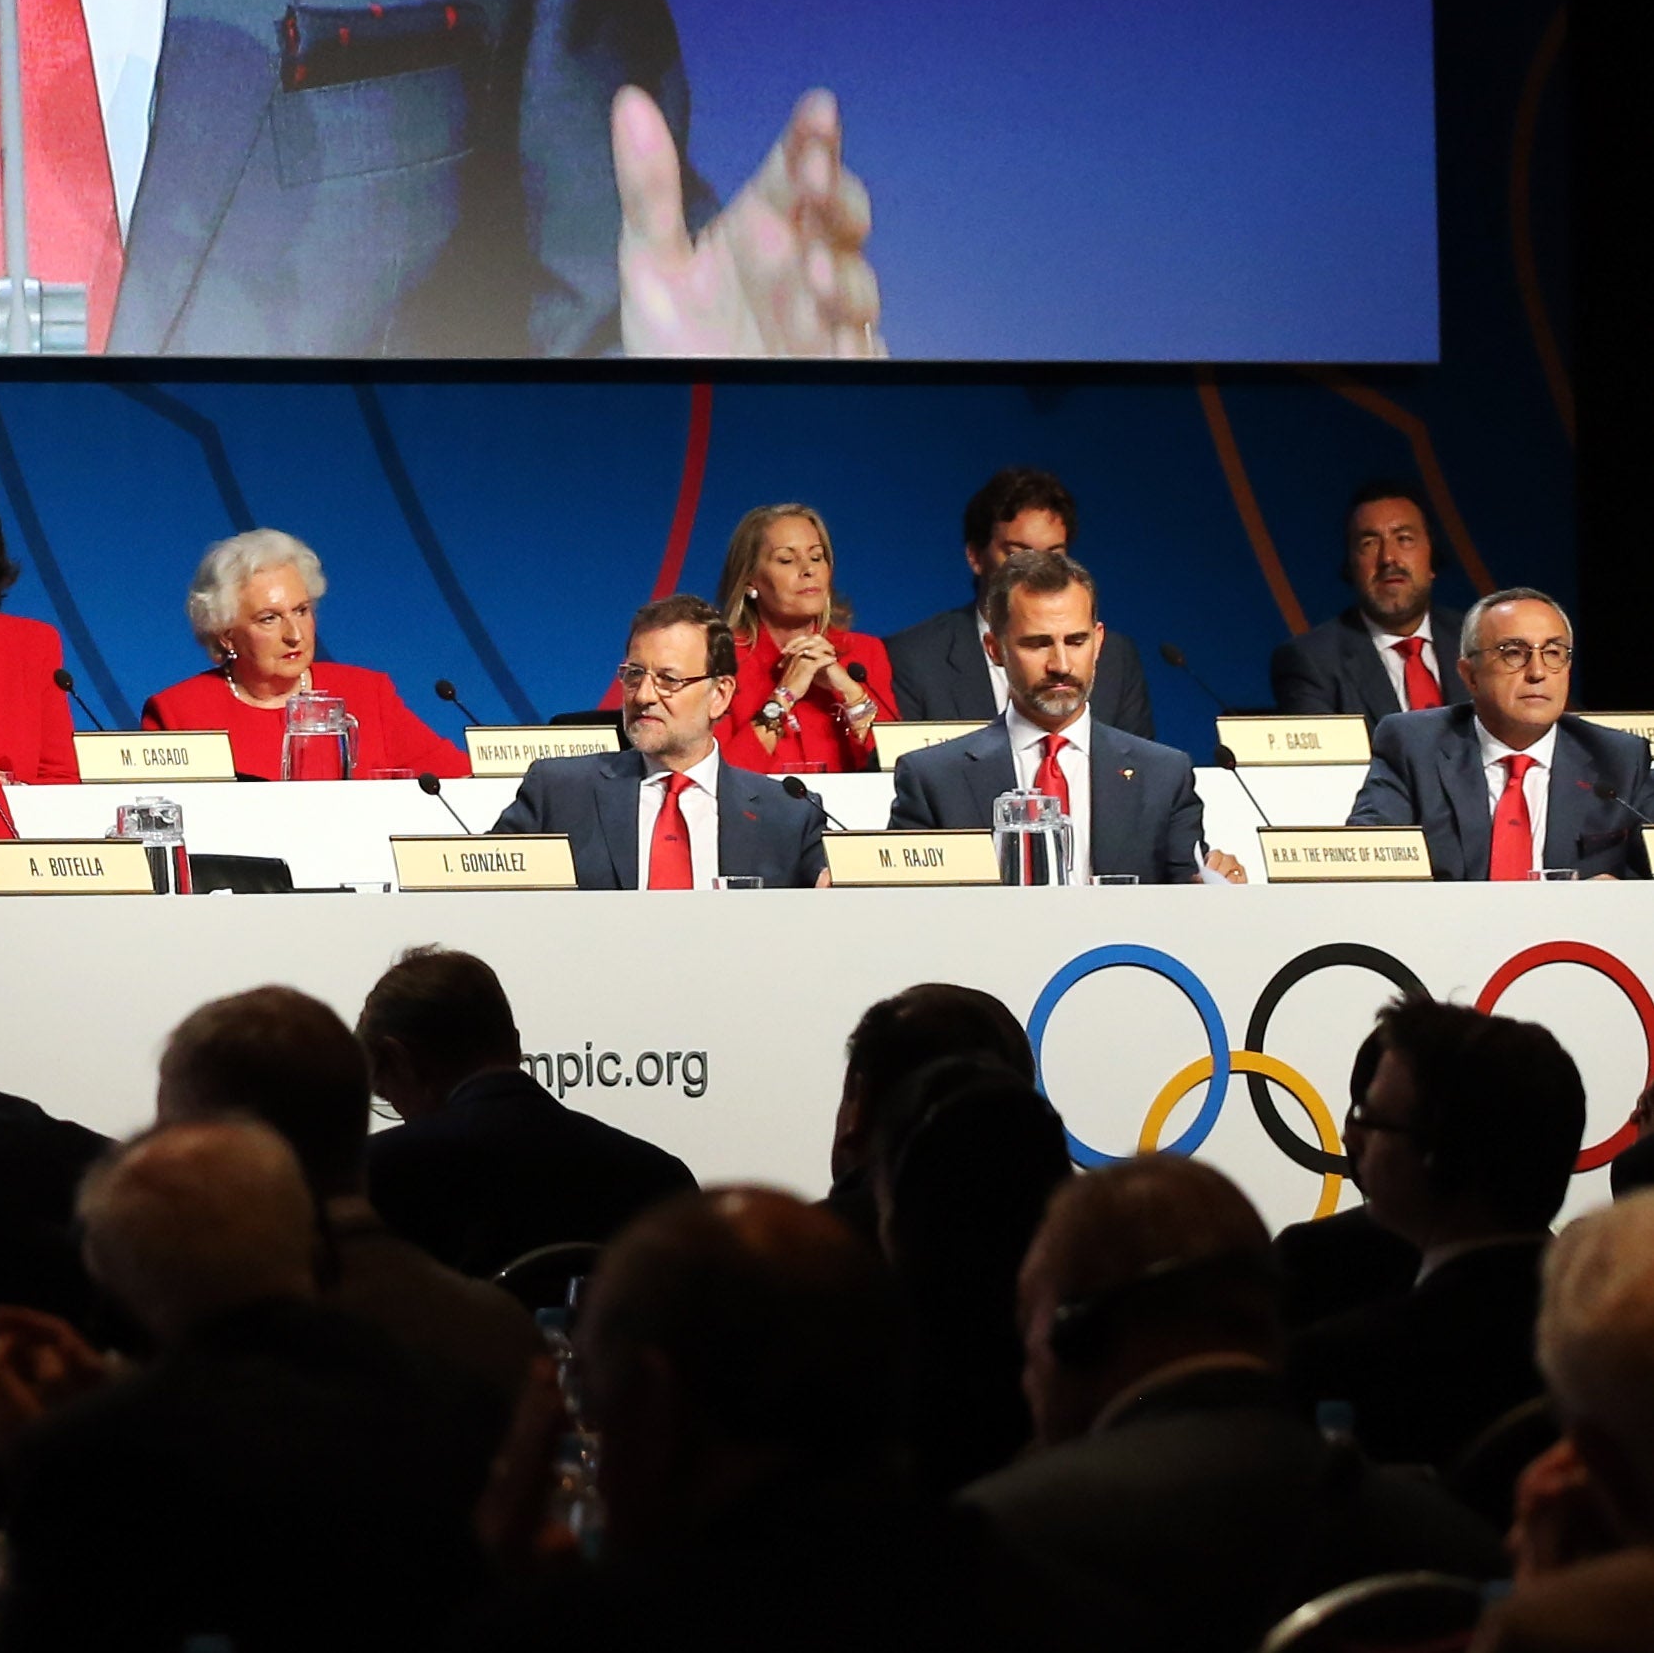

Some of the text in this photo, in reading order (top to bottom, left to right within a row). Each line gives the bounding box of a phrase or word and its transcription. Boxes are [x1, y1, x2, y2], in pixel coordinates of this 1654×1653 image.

[120, 747, 189, 766] M. CASADO
[477, 745, 521, 761] INFANTA
[523, 744, 551, 760] PILAR
[443, 847, 527, 873] I. GONZÁLEZ
[878, 848, 945, 868] M. RAJOY
[1303, 848, 1321, 862] THE
[1323, 847, 1357, 862] PRINCE
[1359, 847, 1371, 861] OF
[1374, 846, 1419, 861] ASTURIAS
[29, 857, 104, 877] A. BOTELLA
